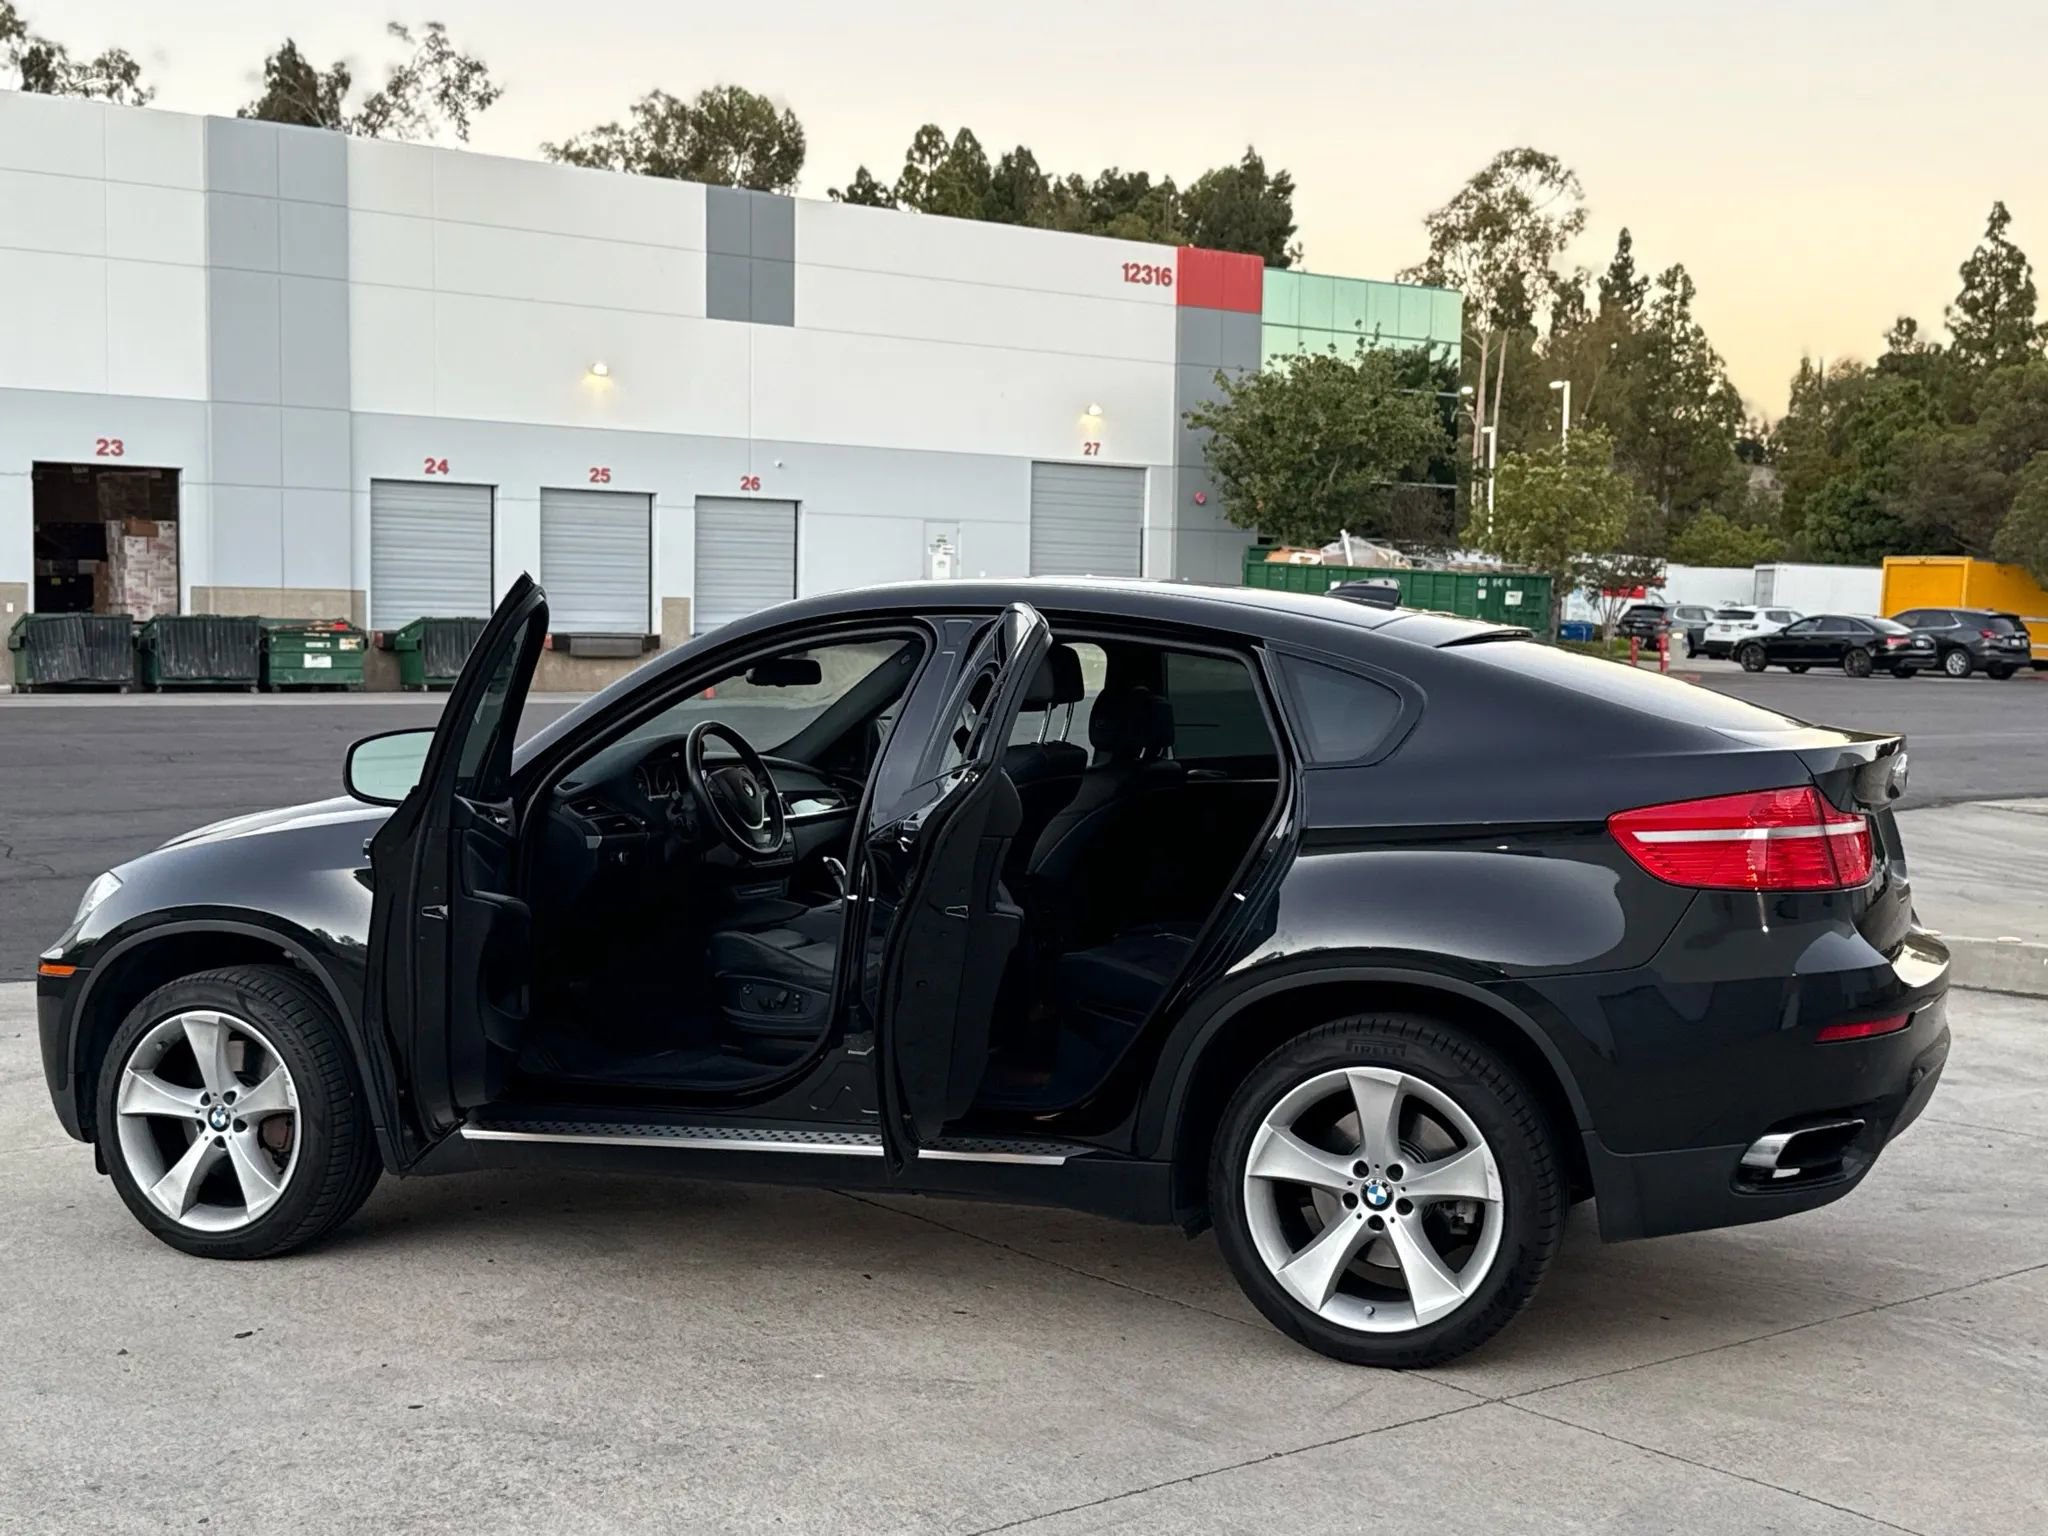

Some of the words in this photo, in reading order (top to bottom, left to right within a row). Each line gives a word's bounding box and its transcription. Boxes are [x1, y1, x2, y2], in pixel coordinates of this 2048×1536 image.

[1122, 263, 1172, 286] 12316
[96, 439, 124, 456] 23
[1084, 442, 1100, 456] 27
[424, 458, 449, 474] 24
[590, 468, 611, 483] 25
[740, 476, 761, 491] 26
